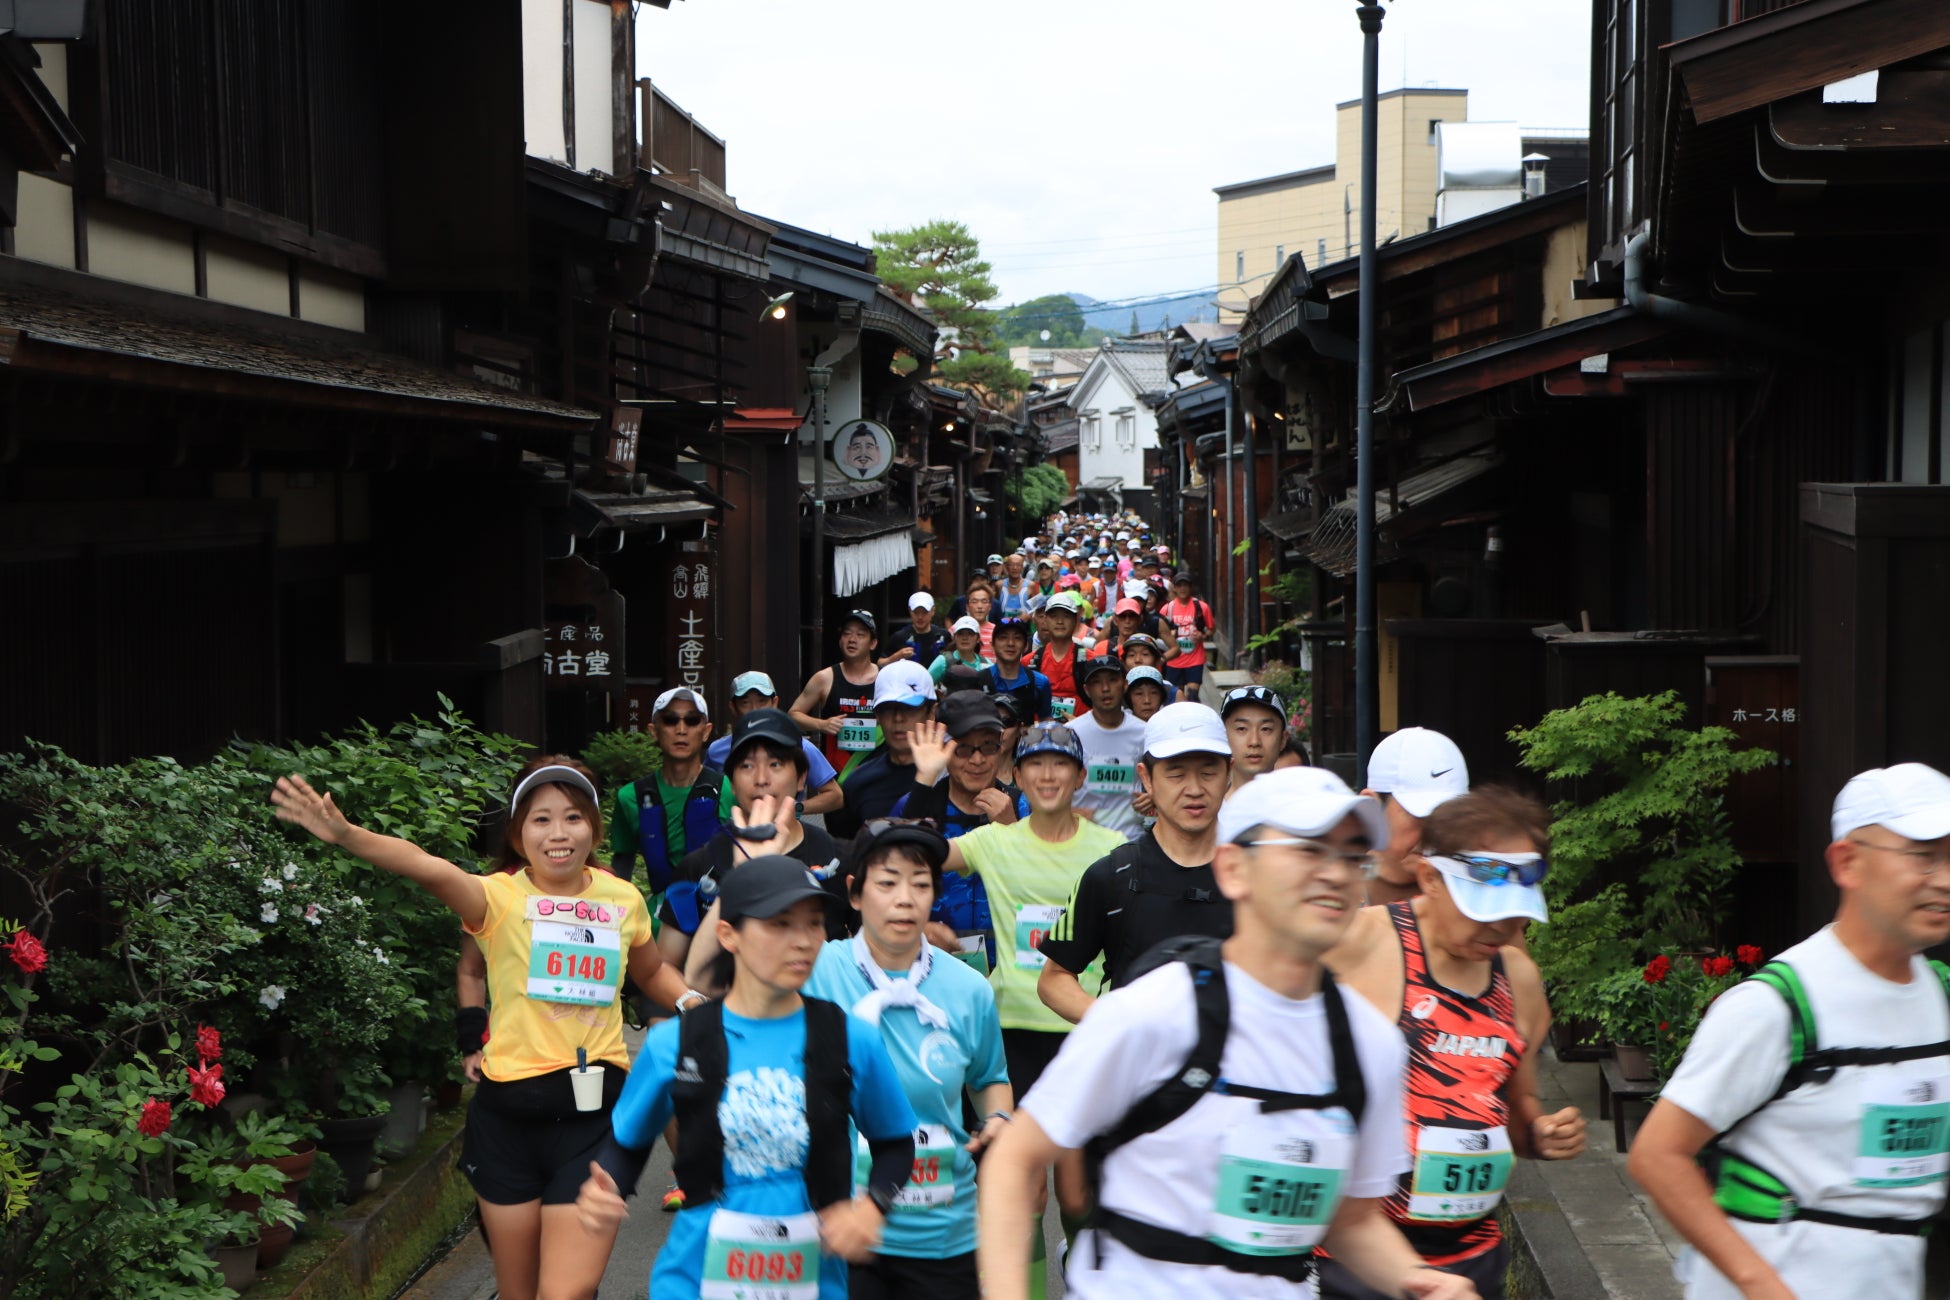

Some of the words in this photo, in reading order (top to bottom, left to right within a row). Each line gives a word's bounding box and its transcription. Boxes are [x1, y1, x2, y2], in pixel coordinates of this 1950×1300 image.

[1732, 708, 1800, 722] ホース格
[844, 730, 870, 741] 5715
[1097, 769, 1126, 782] 5407
[547, 951, 606, 981] 6148
[1428, 1032, 1507, 1059] JAPAN
[1443, 1161, 1494, 1193] 513
[727, 1248, 804, 1281] 6093
